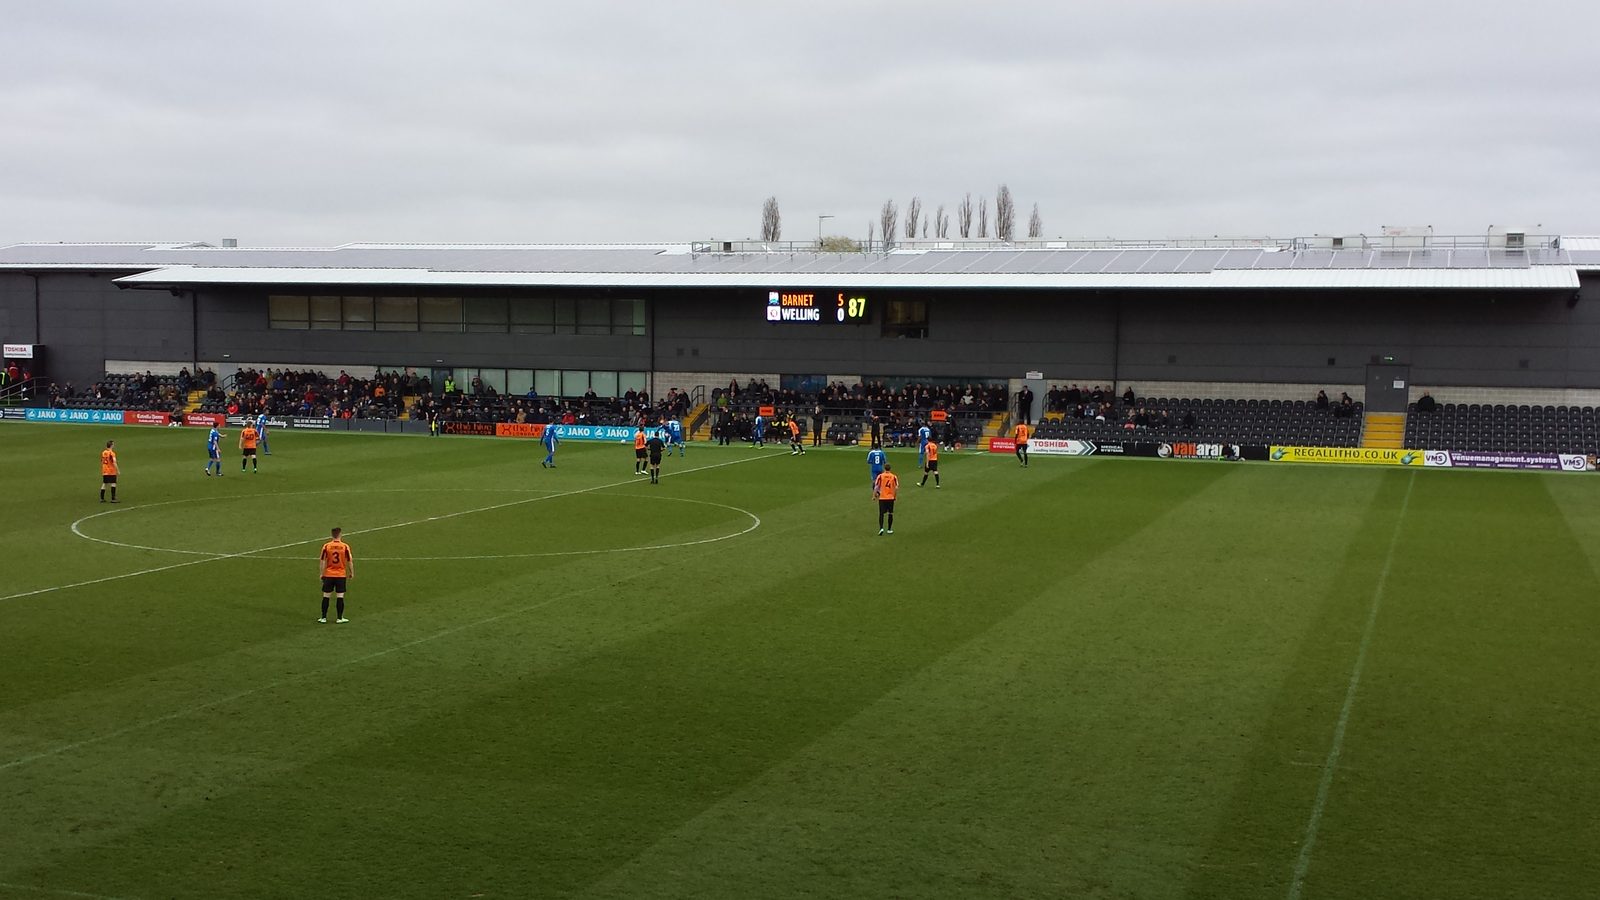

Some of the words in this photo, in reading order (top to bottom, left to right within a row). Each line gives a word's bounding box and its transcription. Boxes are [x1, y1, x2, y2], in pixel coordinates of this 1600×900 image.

[782, 294, 814, 306] BARNET
[837, 293, 844, 306] 5
[848, 298, 865, 317] 87
[781, 308, 820, 321] WELLING
[837, 308, 845, 321] 0
[102, 412, 121, 420] JAKO
[567, 427, 590, 436] JAKO
[605, 429, 628, 438] JAKO
[1033, 440, 1069, 448] TOSHIBA
[1294, 448, 1398, 459] REGALLITHO.CO.UK
[1452, 454, 1558, 464] venuemanagement.systems
[874, 456, 880, 464] 8
[332, 552, 340, 564] 3
